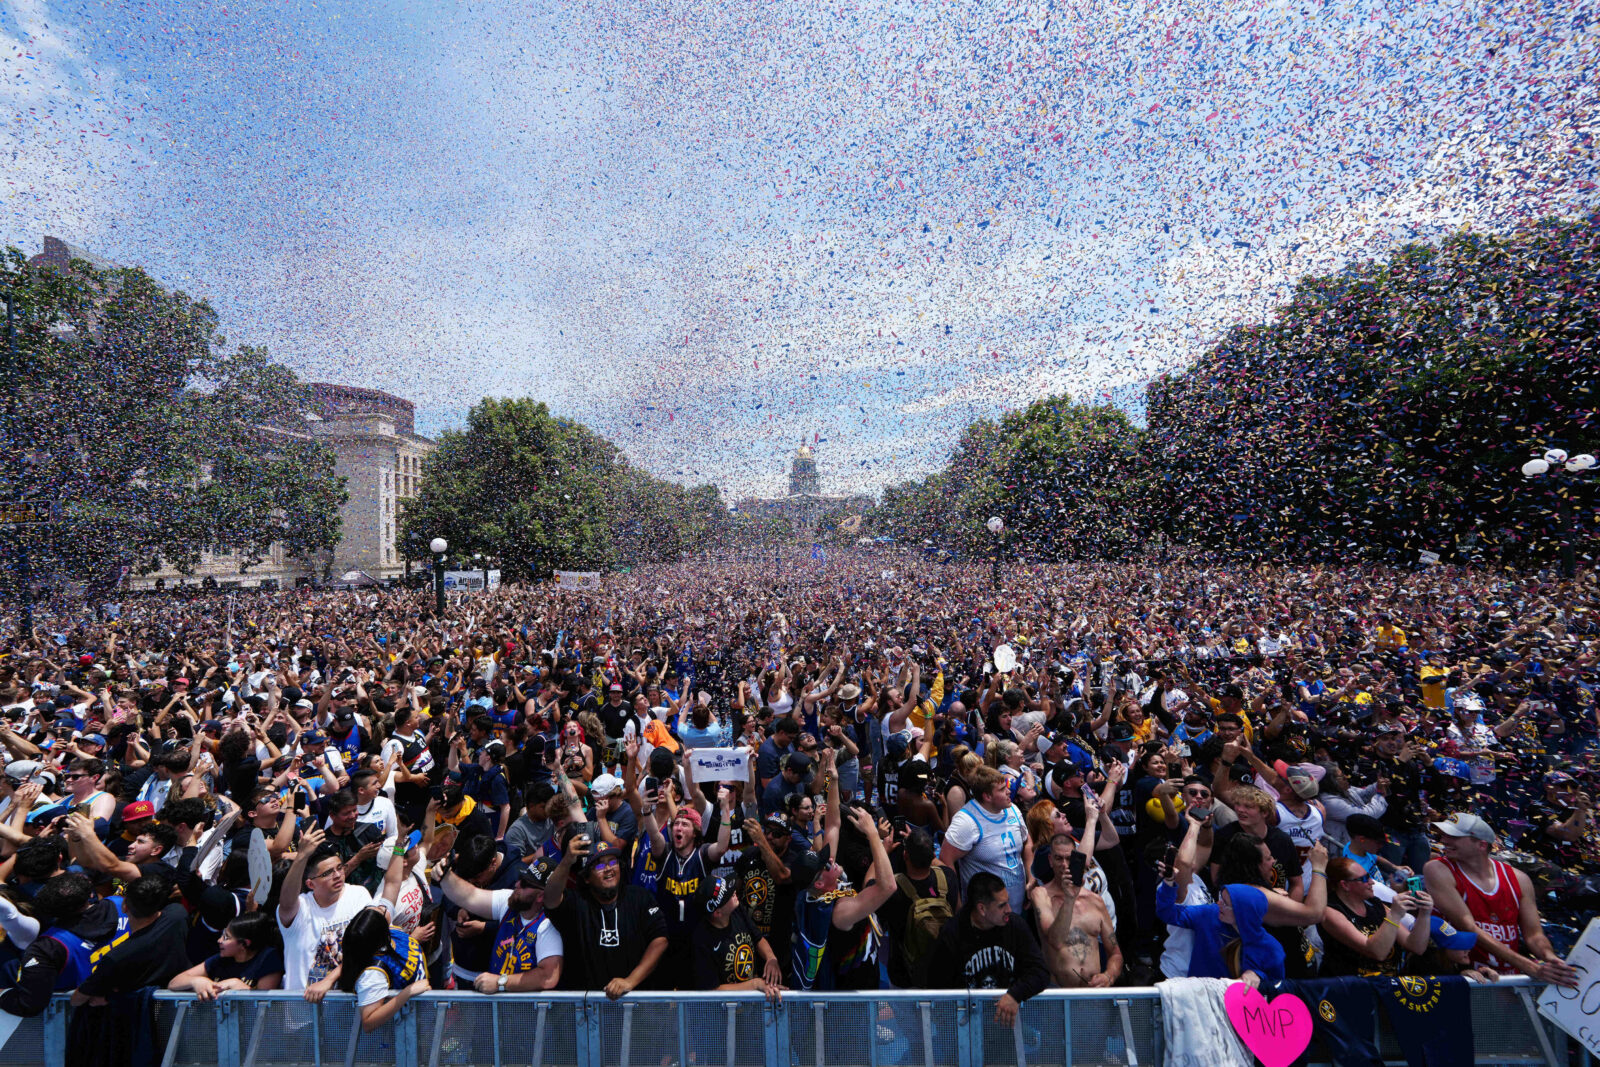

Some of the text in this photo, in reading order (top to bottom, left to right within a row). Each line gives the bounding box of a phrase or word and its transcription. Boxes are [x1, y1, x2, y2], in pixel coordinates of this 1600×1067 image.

[731, 828, 743, 845] 27
[679, 899, 685, 922] 1
[1243, 1006, 1293, 1038] MVP
